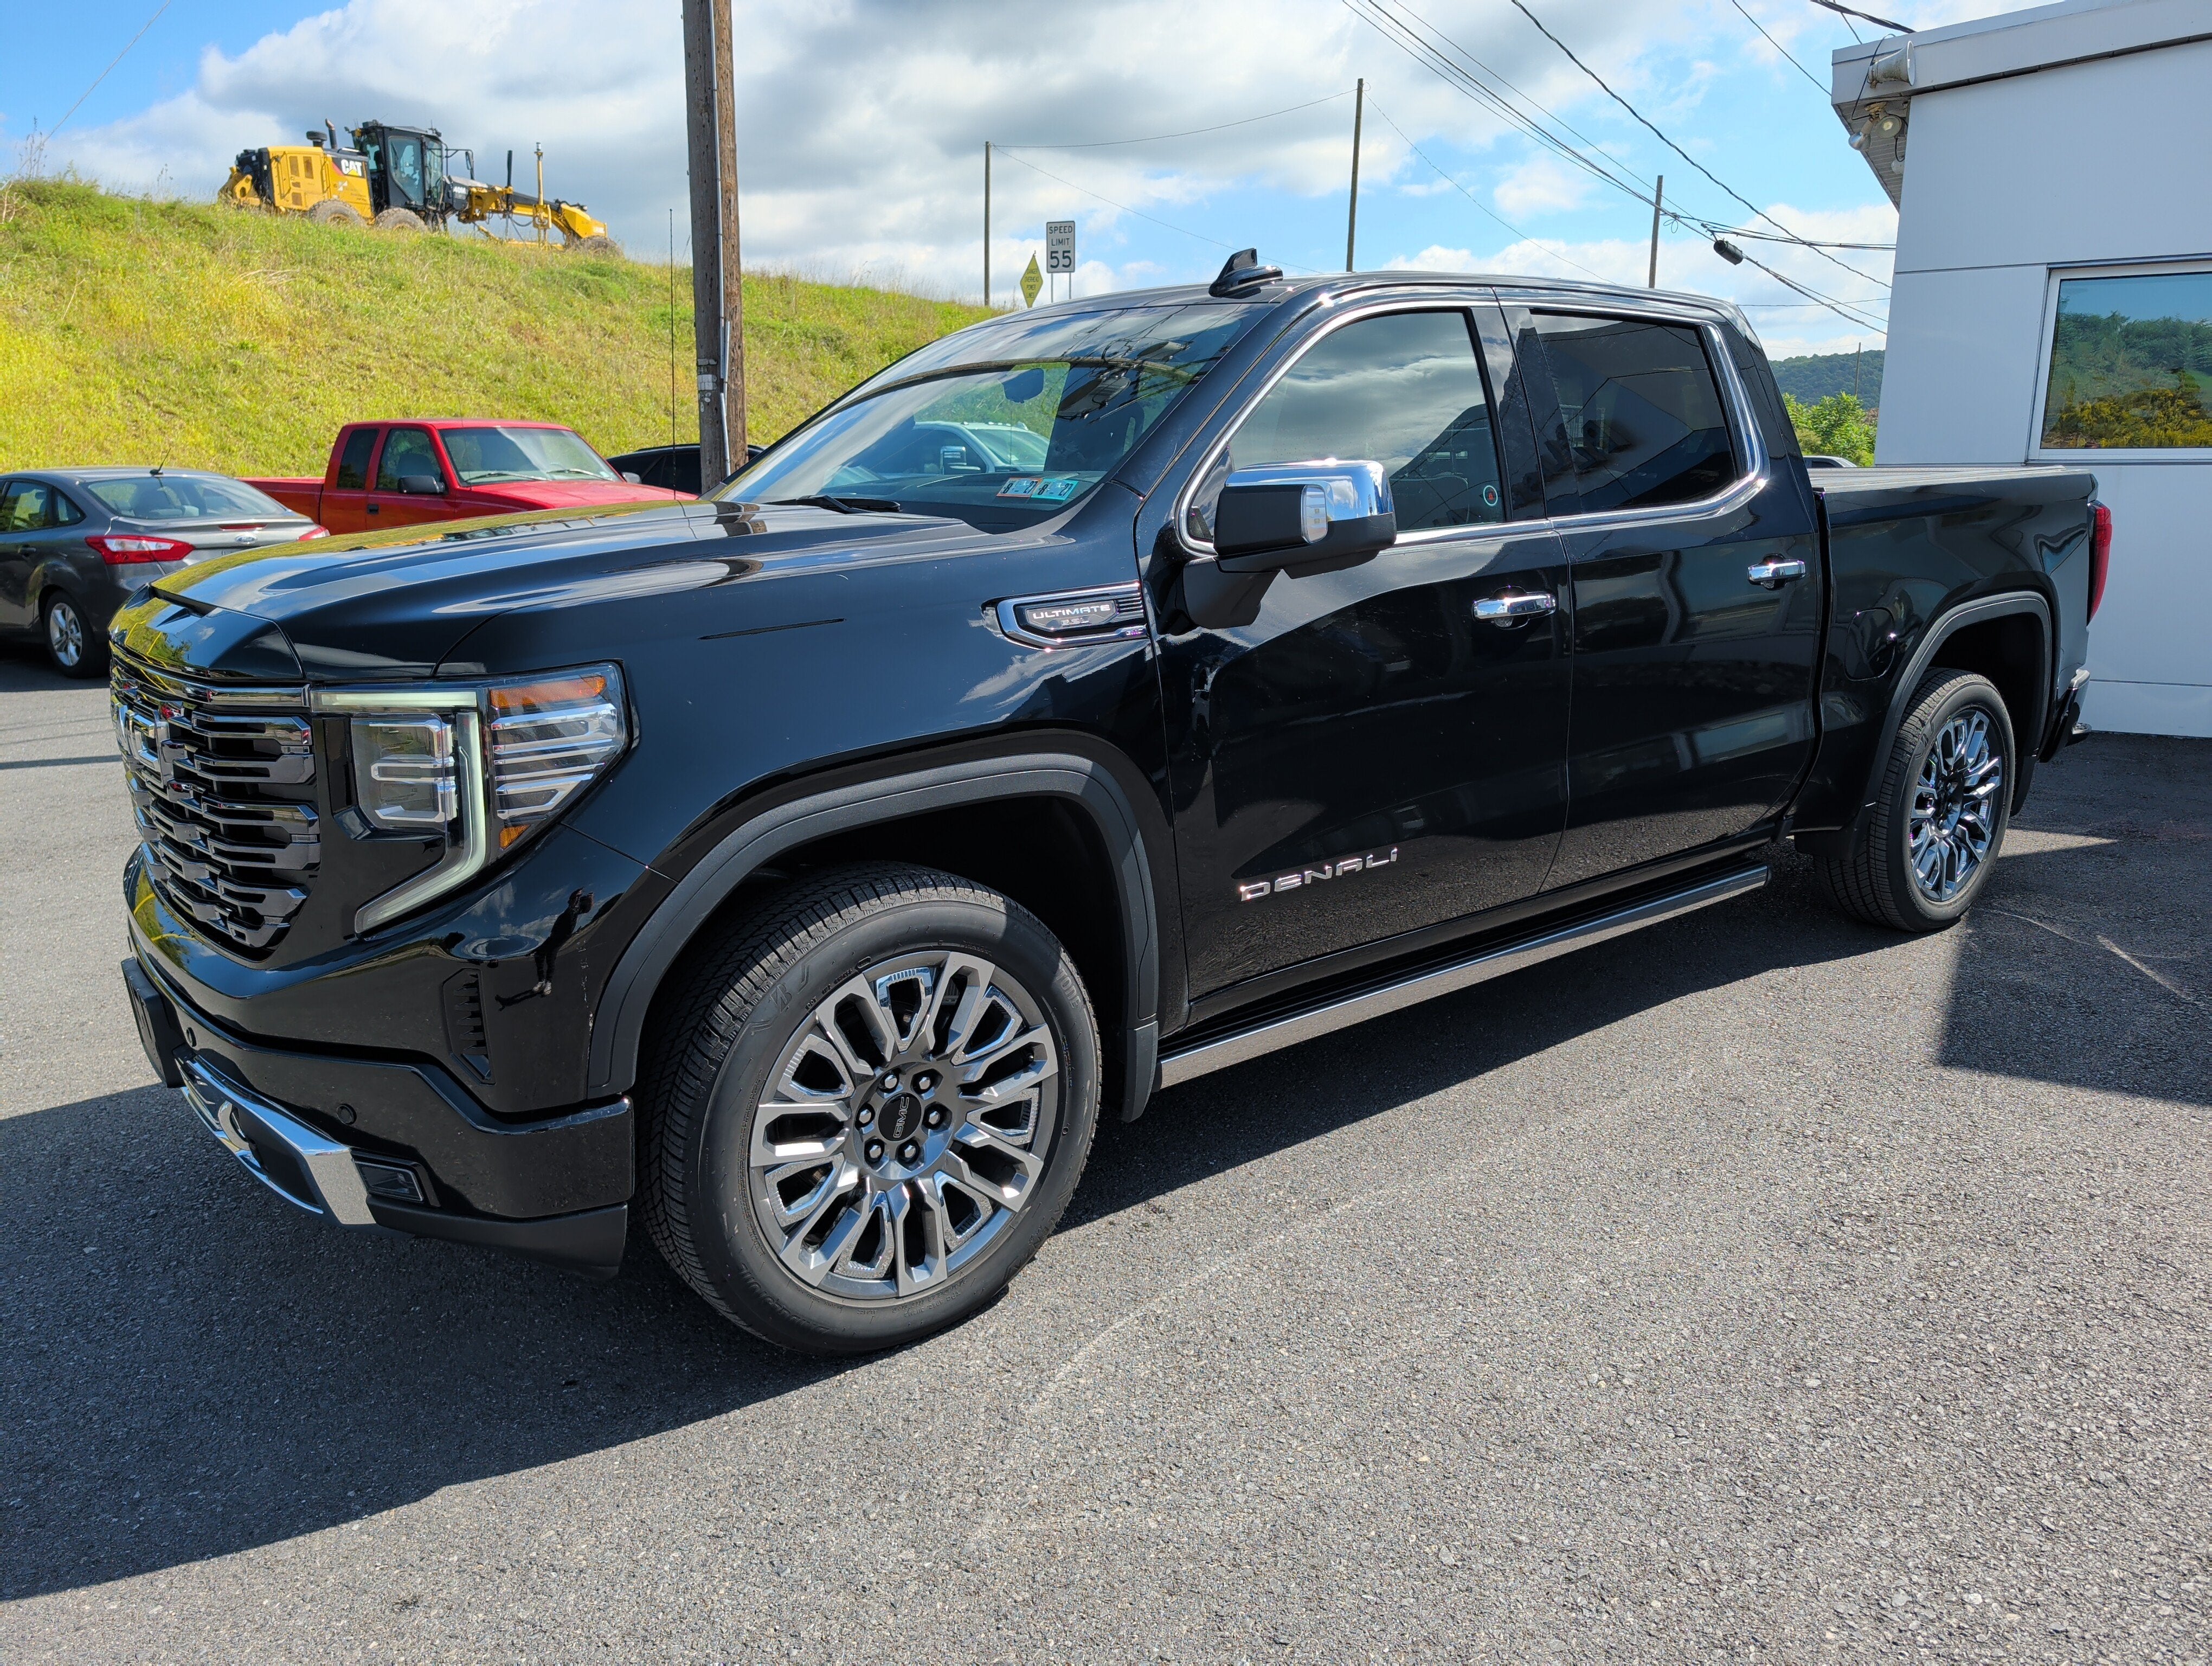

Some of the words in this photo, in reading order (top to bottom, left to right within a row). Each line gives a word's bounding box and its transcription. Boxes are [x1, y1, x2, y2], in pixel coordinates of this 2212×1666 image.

[340, 159, 362, 176] CAT
[1049, 225, 1073, 234] SPEED
[1051, 238, 1070, 246] LIMIT
[1050, 250, 1072, 269] 55
[1032, 604, 1111, 619] ULTIMATE
[1240, 847, 1398, 902] DENALI
[893, 1097, 910, 1138] GMC
